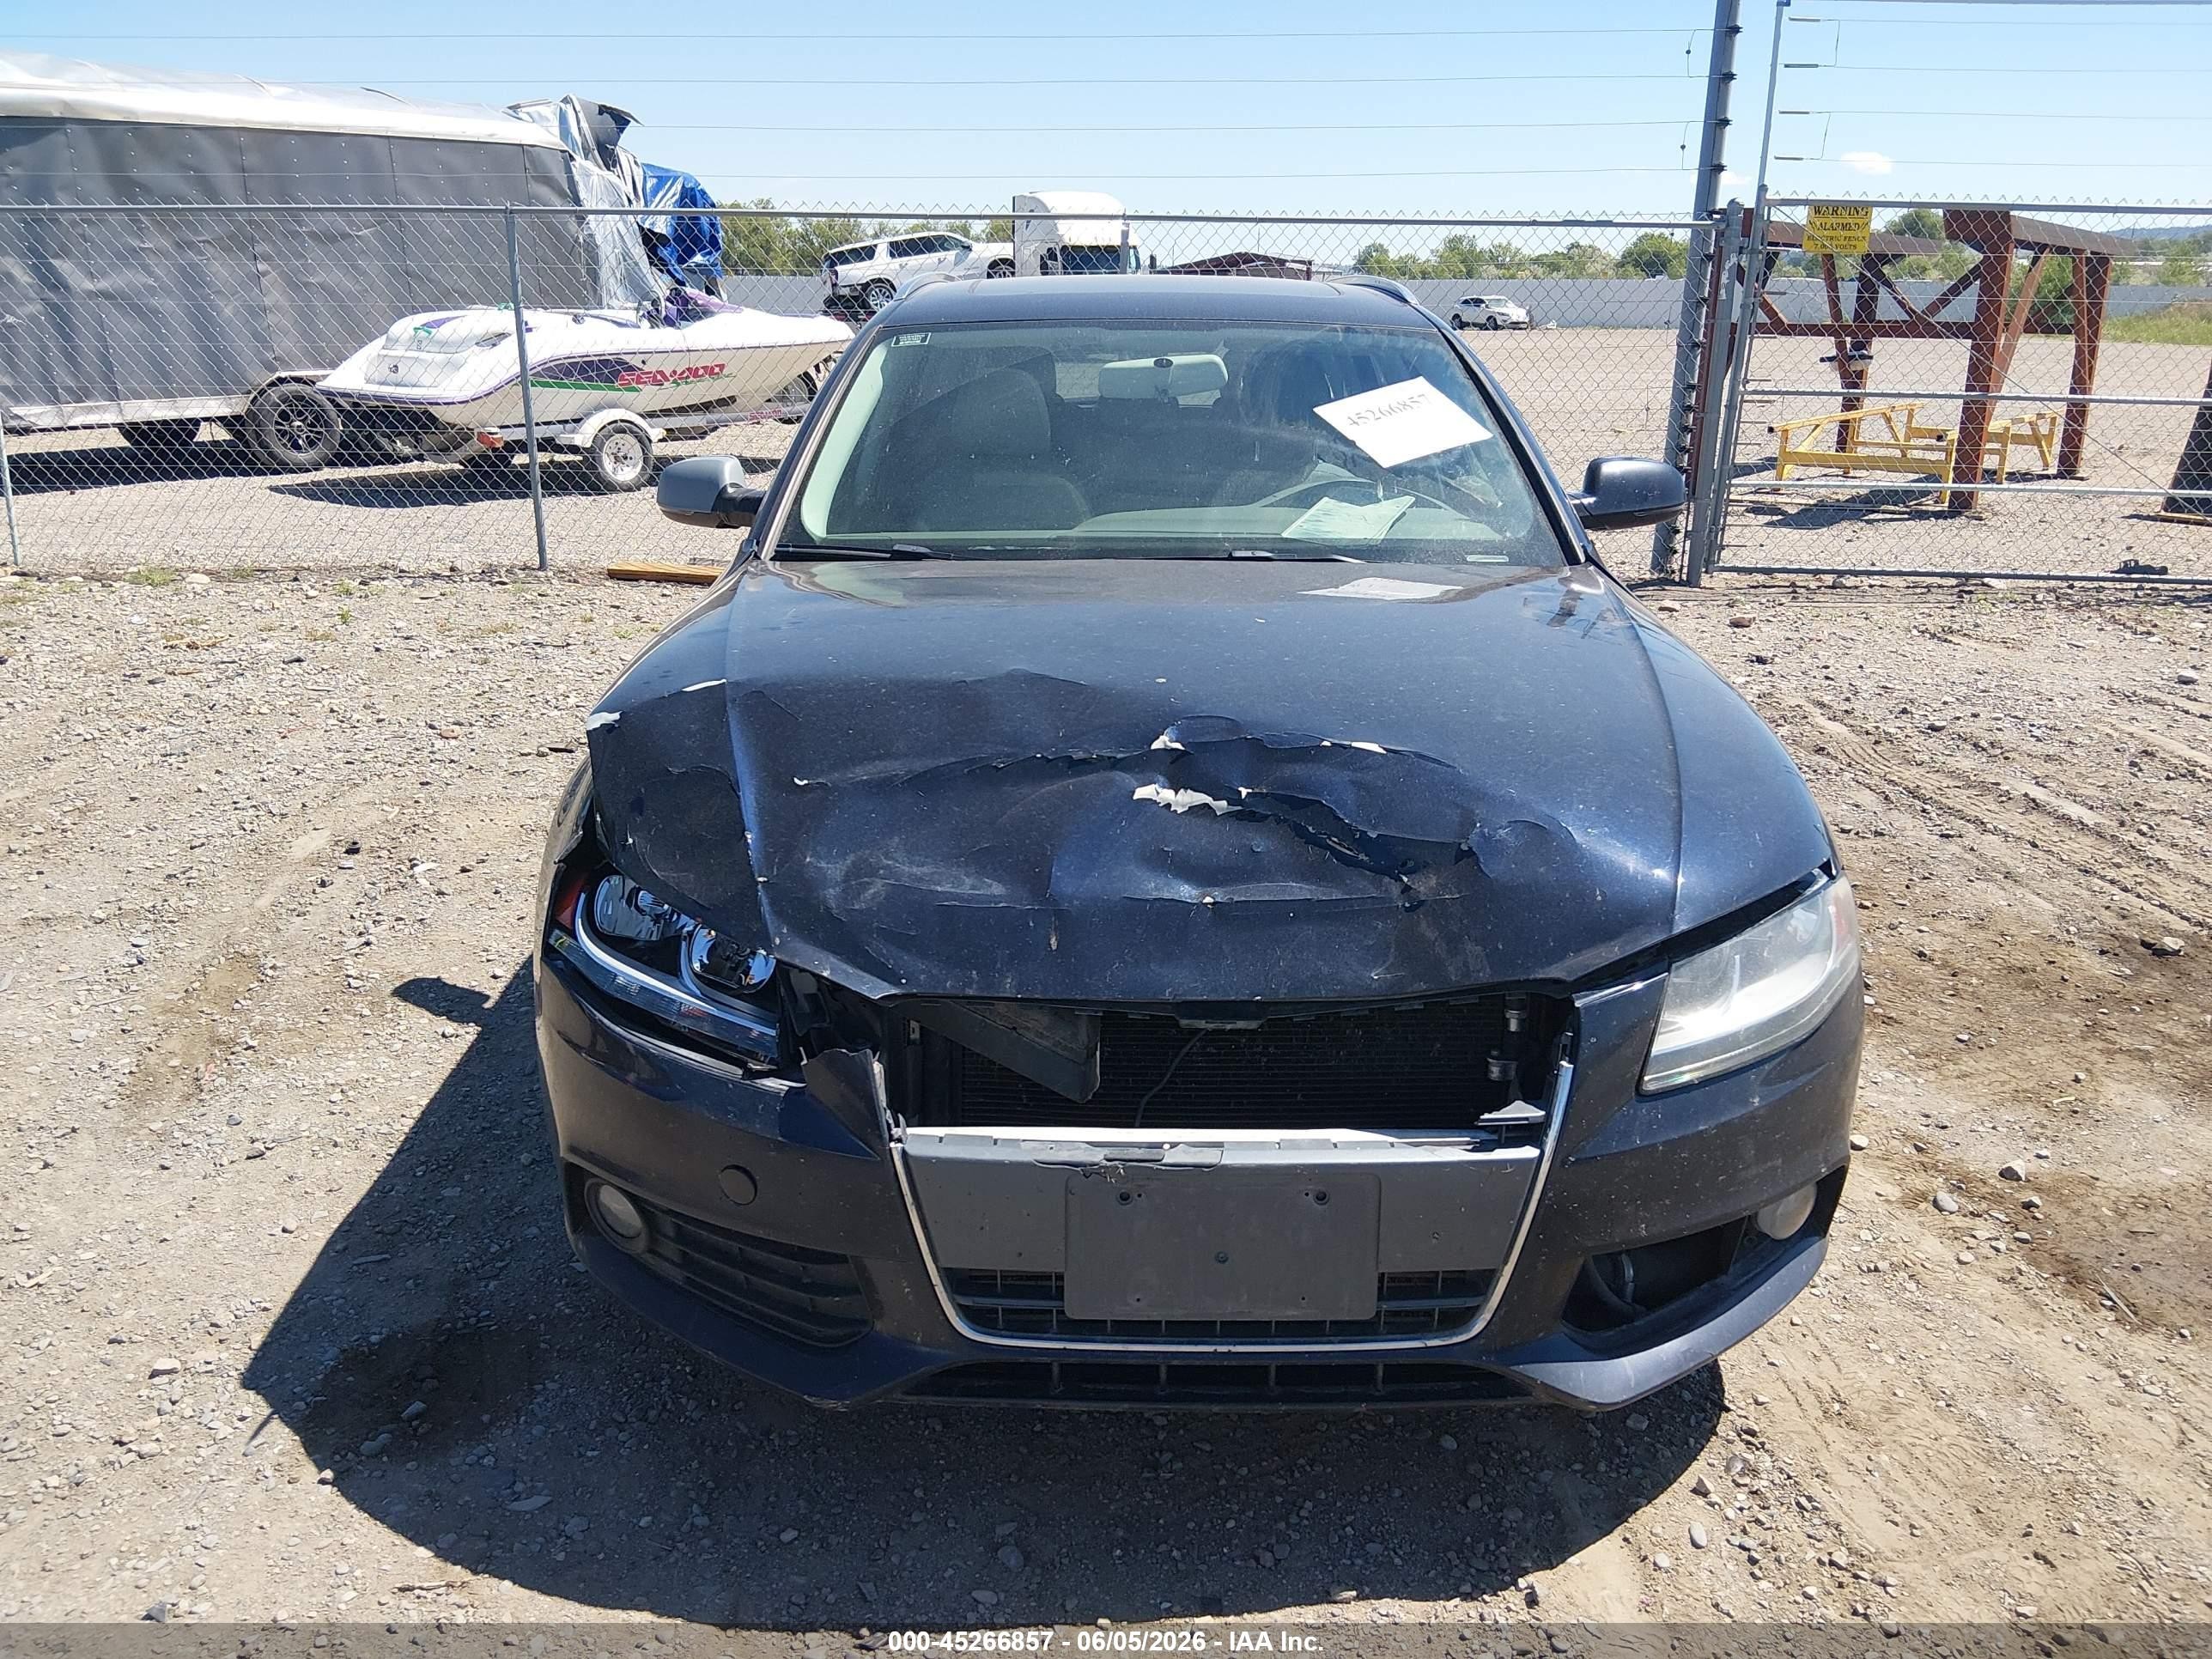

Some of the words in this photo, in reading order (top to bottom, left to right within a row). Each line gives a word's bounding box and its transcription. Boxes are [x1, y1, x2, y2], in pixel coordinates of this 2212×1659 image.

[1814, 206, 1869, 216] WARNING
[1818, 222, 1860, 232] ALARMED
[1346, 393, 1432, 427] 45266857
